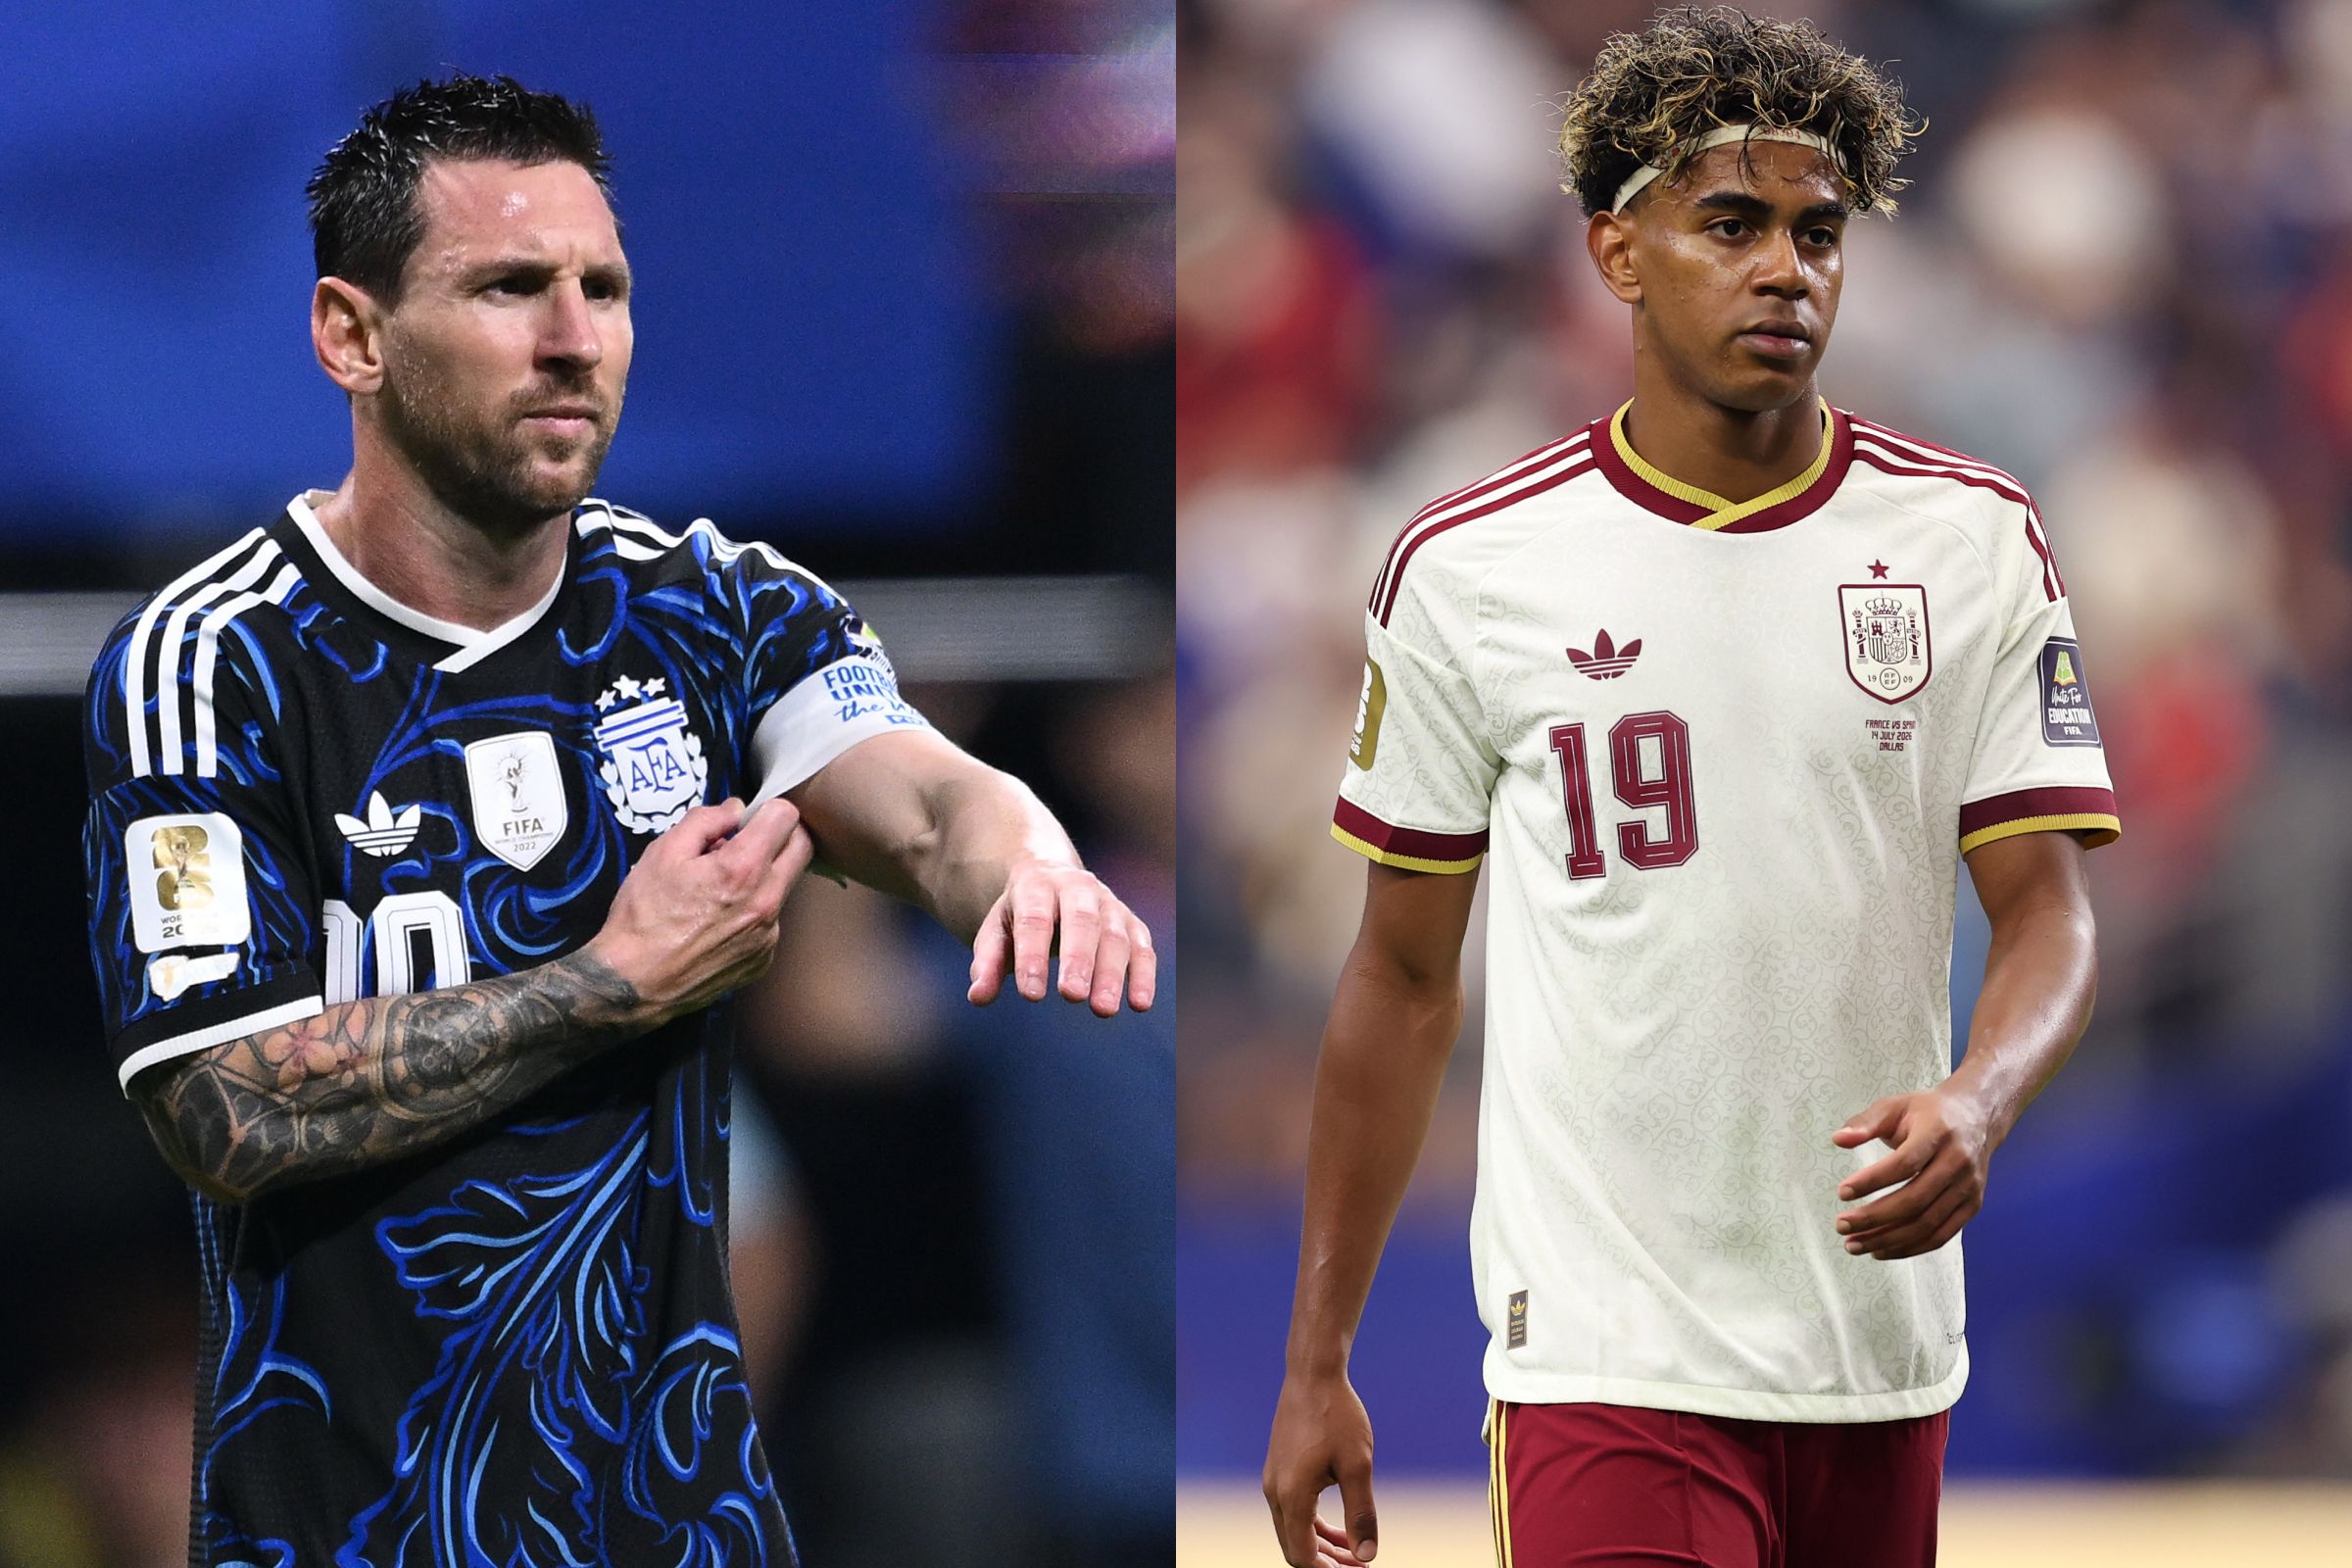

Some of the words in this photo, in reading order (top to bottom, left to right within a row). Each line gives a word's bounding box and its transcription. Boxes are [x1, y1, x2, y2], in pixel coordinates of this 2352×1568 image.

[1868, 674, 1878, 683] 19
[2068, 687, 2082, 707] For
[833, 701, 885, 723] the
[2048, 708, 2091, 723] EDUCATION
[1865, 719, 1890, 729] FRANCE
[1891, 720, 1901, 730] VS
[2064, 726, 2082, 735] FIFA
[1871, 730, 1879, 740] 14
[1880, 730, 1895, 741] JULY
[1896, 731, 1912, 741] 2026
[1879, 742, 1904, 752] DALLAS
[626, 736, 687, 794] AFA
[1548, 710, 1699, 881] 19
[503, 817, 544, 837] FIFA
[514, 841, 537, 853] 2022
[161, 914, 182, 924] WOR
